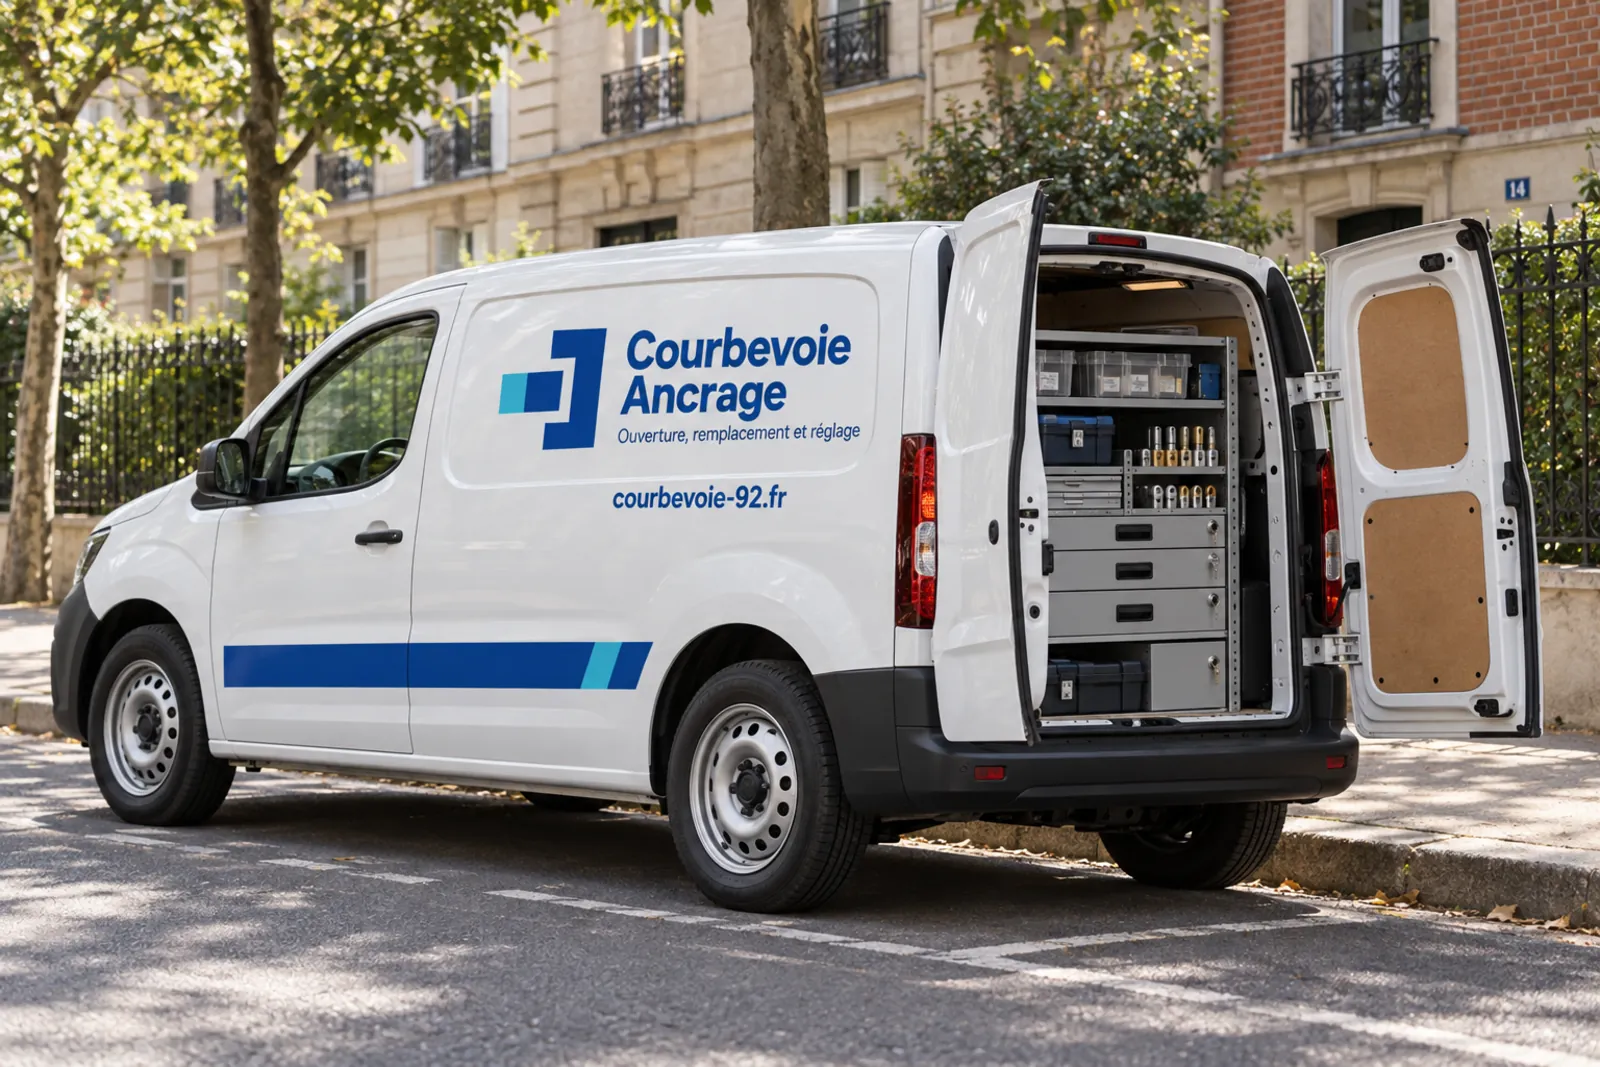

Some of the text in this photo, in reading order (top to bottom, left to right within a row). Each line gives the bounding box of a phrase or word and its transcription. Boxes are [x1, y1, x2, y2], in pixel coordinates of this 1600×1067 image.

[1509, 180, 1526, 198] 14
[626, 323, 852, 371] Courbevoie
[620, 375, 788, 422] Ancrage
[617, 422, 861, 445] Ouverture, remplacement et réglage
[612, 484, 788, 510] courbevoie-92.fr
